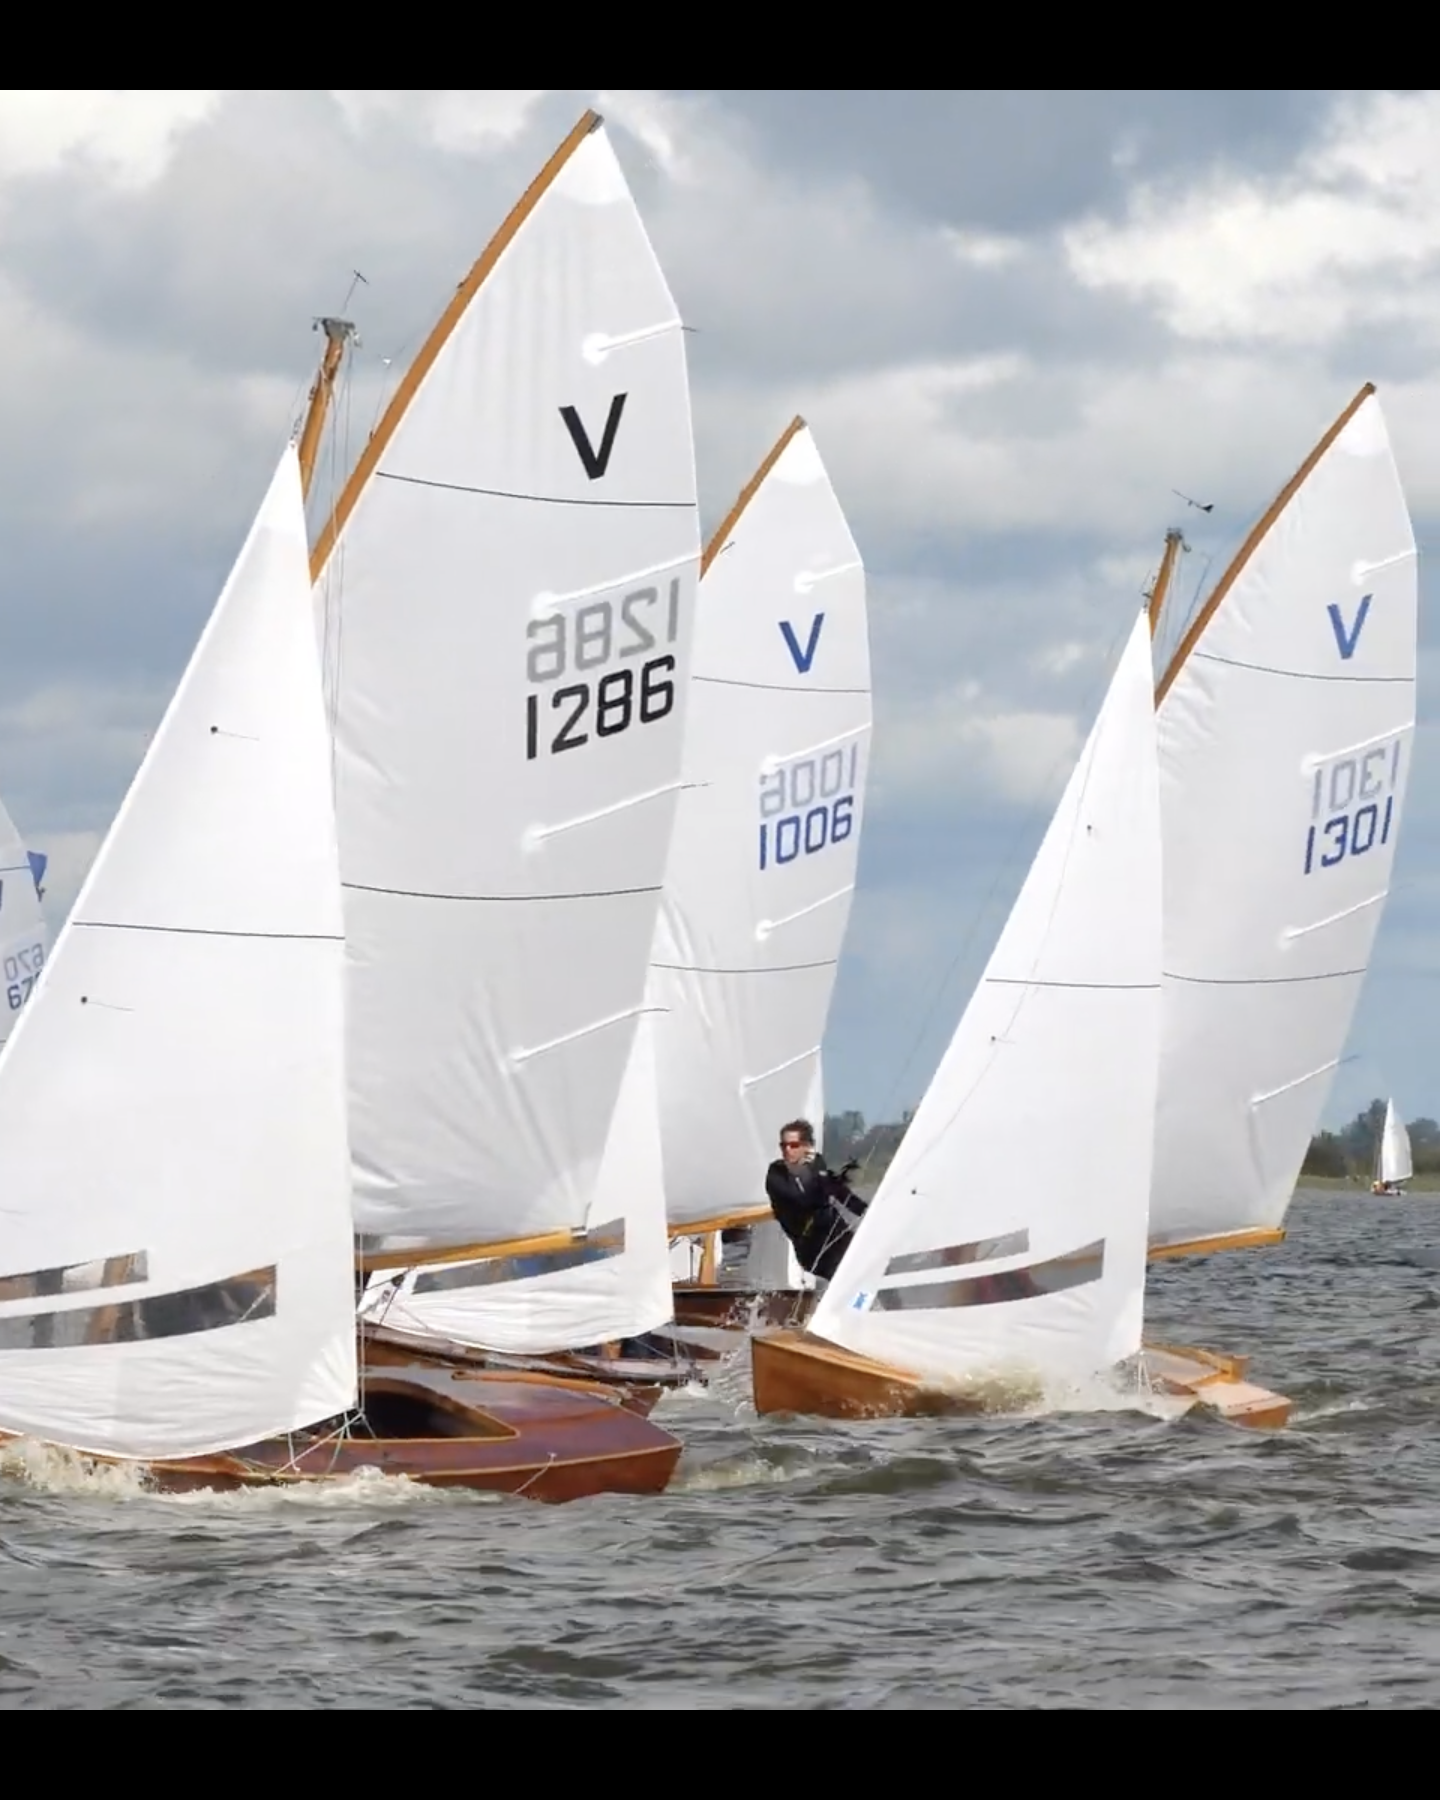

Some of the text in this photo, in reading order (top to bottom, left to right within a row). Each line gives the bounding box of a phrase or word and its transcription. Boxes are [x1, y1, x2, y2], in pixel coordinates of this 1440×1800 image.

[559, 392, 628, 480] V
[778, 612, 825, 673] V
[1326, 594, 1373, 660] V
[526, 654, 675, 761] 1286
[760, 795, 854, 870] 1006
[1304, 796, 1394, 874] 1301
